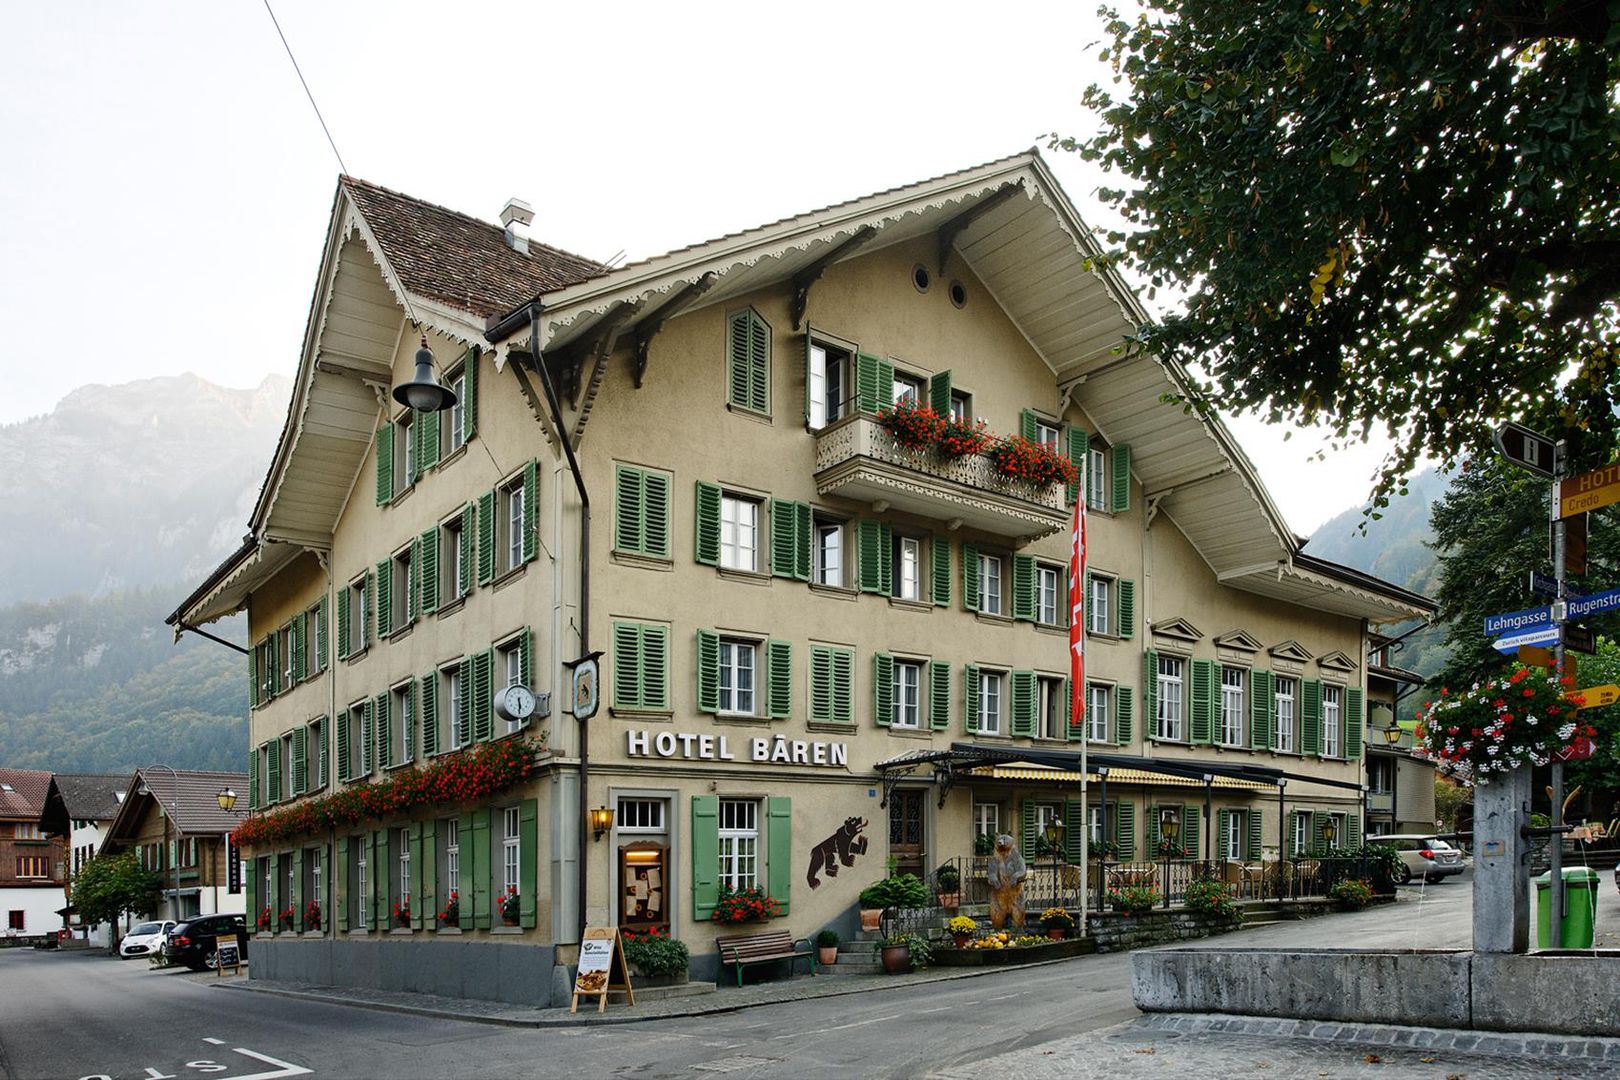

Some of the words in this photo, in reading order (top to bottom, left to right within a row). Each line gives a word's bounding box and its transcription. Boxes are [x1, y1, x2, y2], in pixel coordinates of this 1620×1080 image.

[1569, 494, 1599, 511] Credo
[1488, 611, 1547, 631] Lehngasse
[627, 730, 735, 760] HOTEL
[751, 734, 848, 765] BÄREN
